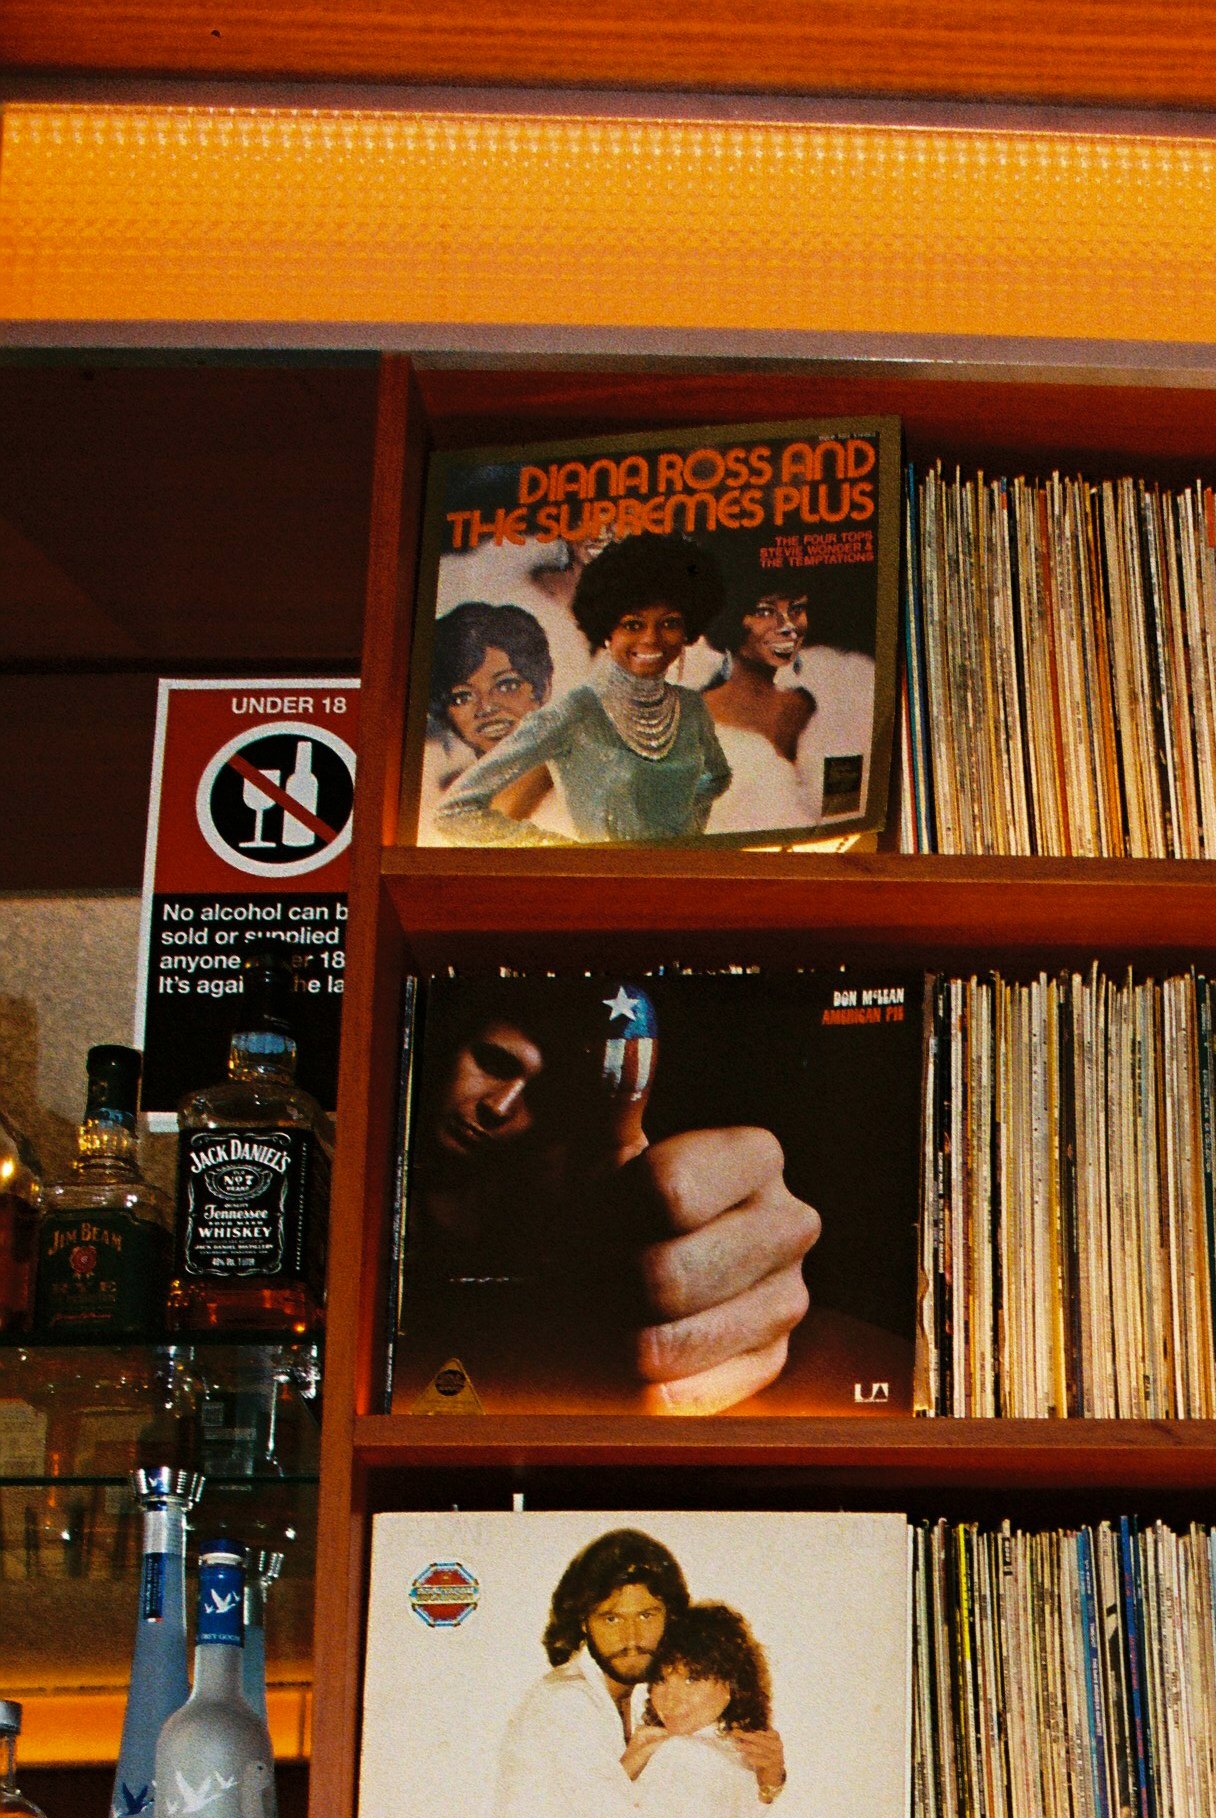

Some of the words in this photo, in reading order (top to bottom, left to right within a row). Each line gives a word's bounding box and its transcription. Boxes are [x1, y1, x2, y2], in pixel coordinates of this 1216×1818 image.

[519, 455, 648, 504] DIANA
[656, 447, 773, 493] ROSS
[782, 439, 876, 482] AND
[447, 507, 527, 548] THE
[535, 488, 764, 544] SUPREMES
[773, 482, 875, 526] PLUS
[775, 535, 799, 546] THE
[842, 530, 873, 543] TOPS
[760, 546, 802, 559] STEVIE
[807, 543, 860, 556] WONDER
[760, 557, 782, 568] THE
[789, 552, 873, 567] TEMPTATIONS
[232, 697, 314, 714] UNDER
[322, 696, 347, 713] 18
[163, 903, 194, 921] No
[200, 903, 282, 921] alcohol
[288, 906, 329, 921] can
[161, 927, 208, 945] sold
[215, 930, 239, 945] or
[160, 955, 241, 973] anyone
[159, 976, 190, 994] It's
[328, 975, 344, 993] la
[833, 990, 857, 1007] DON
[822, 1007, 880, 1025] AMERICAN
[885, 1006, 904, 1022] PIE
[190, 1144, 229, 1174] JACK
[230, 1139, 292, 1174] DANIEL'S
[203, 1204, 269, 1220] Tennessee
[47, 1229, 77, 1256] JIM
[81, 1222, 123, 1252] BEAM
[197, 1226, 272, 1238] WHISKEY
